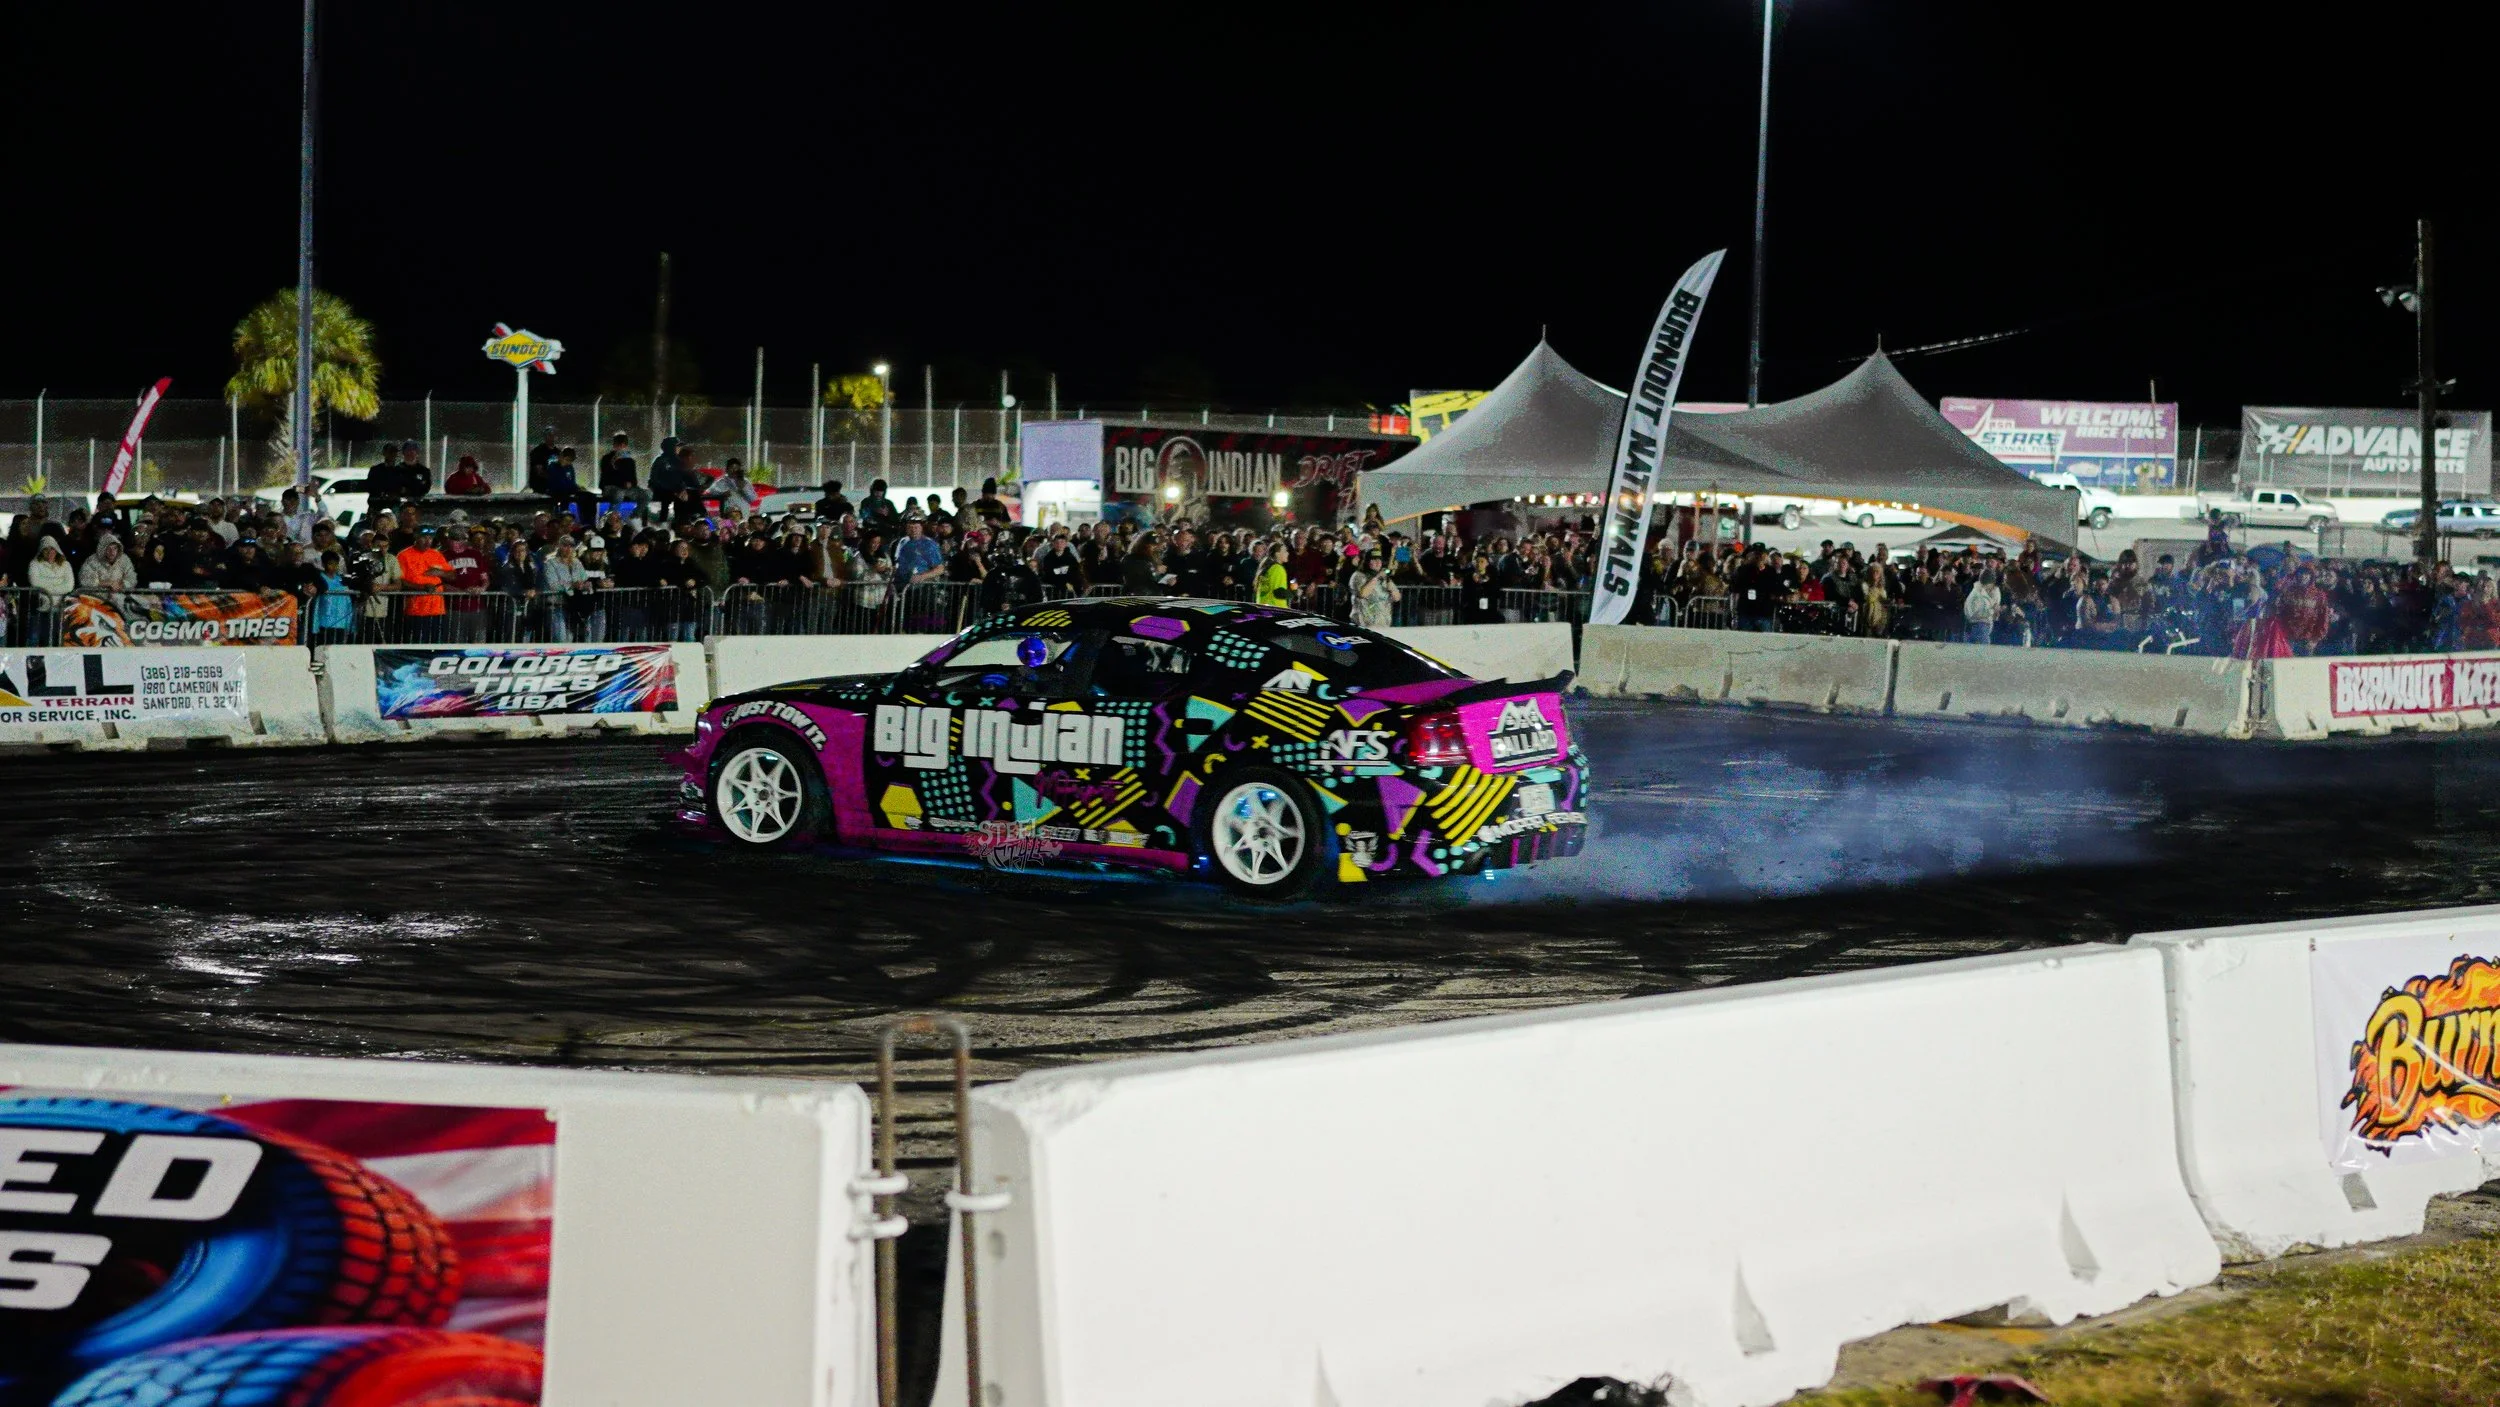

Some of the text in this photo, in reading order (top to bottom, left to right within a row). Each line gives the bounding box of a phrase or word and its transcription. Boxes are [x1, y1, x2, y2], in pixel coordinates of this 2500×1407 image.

[490, 342, 549, 357] SUNOCO
[1634, 288, 1701, 427] BURNOUT
[2040, 407, 2165, 428] WELCOME
[1982, 431, 2062, 445] STARS
[1115, 446, 1282, 498] BIG INDIAN
[2362, 457, 2410, 473] AUTO
[129, 617, 291, 641] COSMO TIRES
[173, 666, 223, 679] 218-6969
[428, 654, 624, 675] COLORED
[142, 681, 166, 695] 1980
[169, 681, 219, 694] CAMERON
[470, 673, 600, 694] TIRES
[2336, 663, 2446, 713] BURNOUT
[41, 697, 134, 707] TERRAIN
[198, 697, 210, 708] FL
[498, 694, 568, 710] USA
[28, 709, 100, 722] SERVICE,
[104, 709, 137, 720] INC.
[771, 702, 813, 729] TOW
